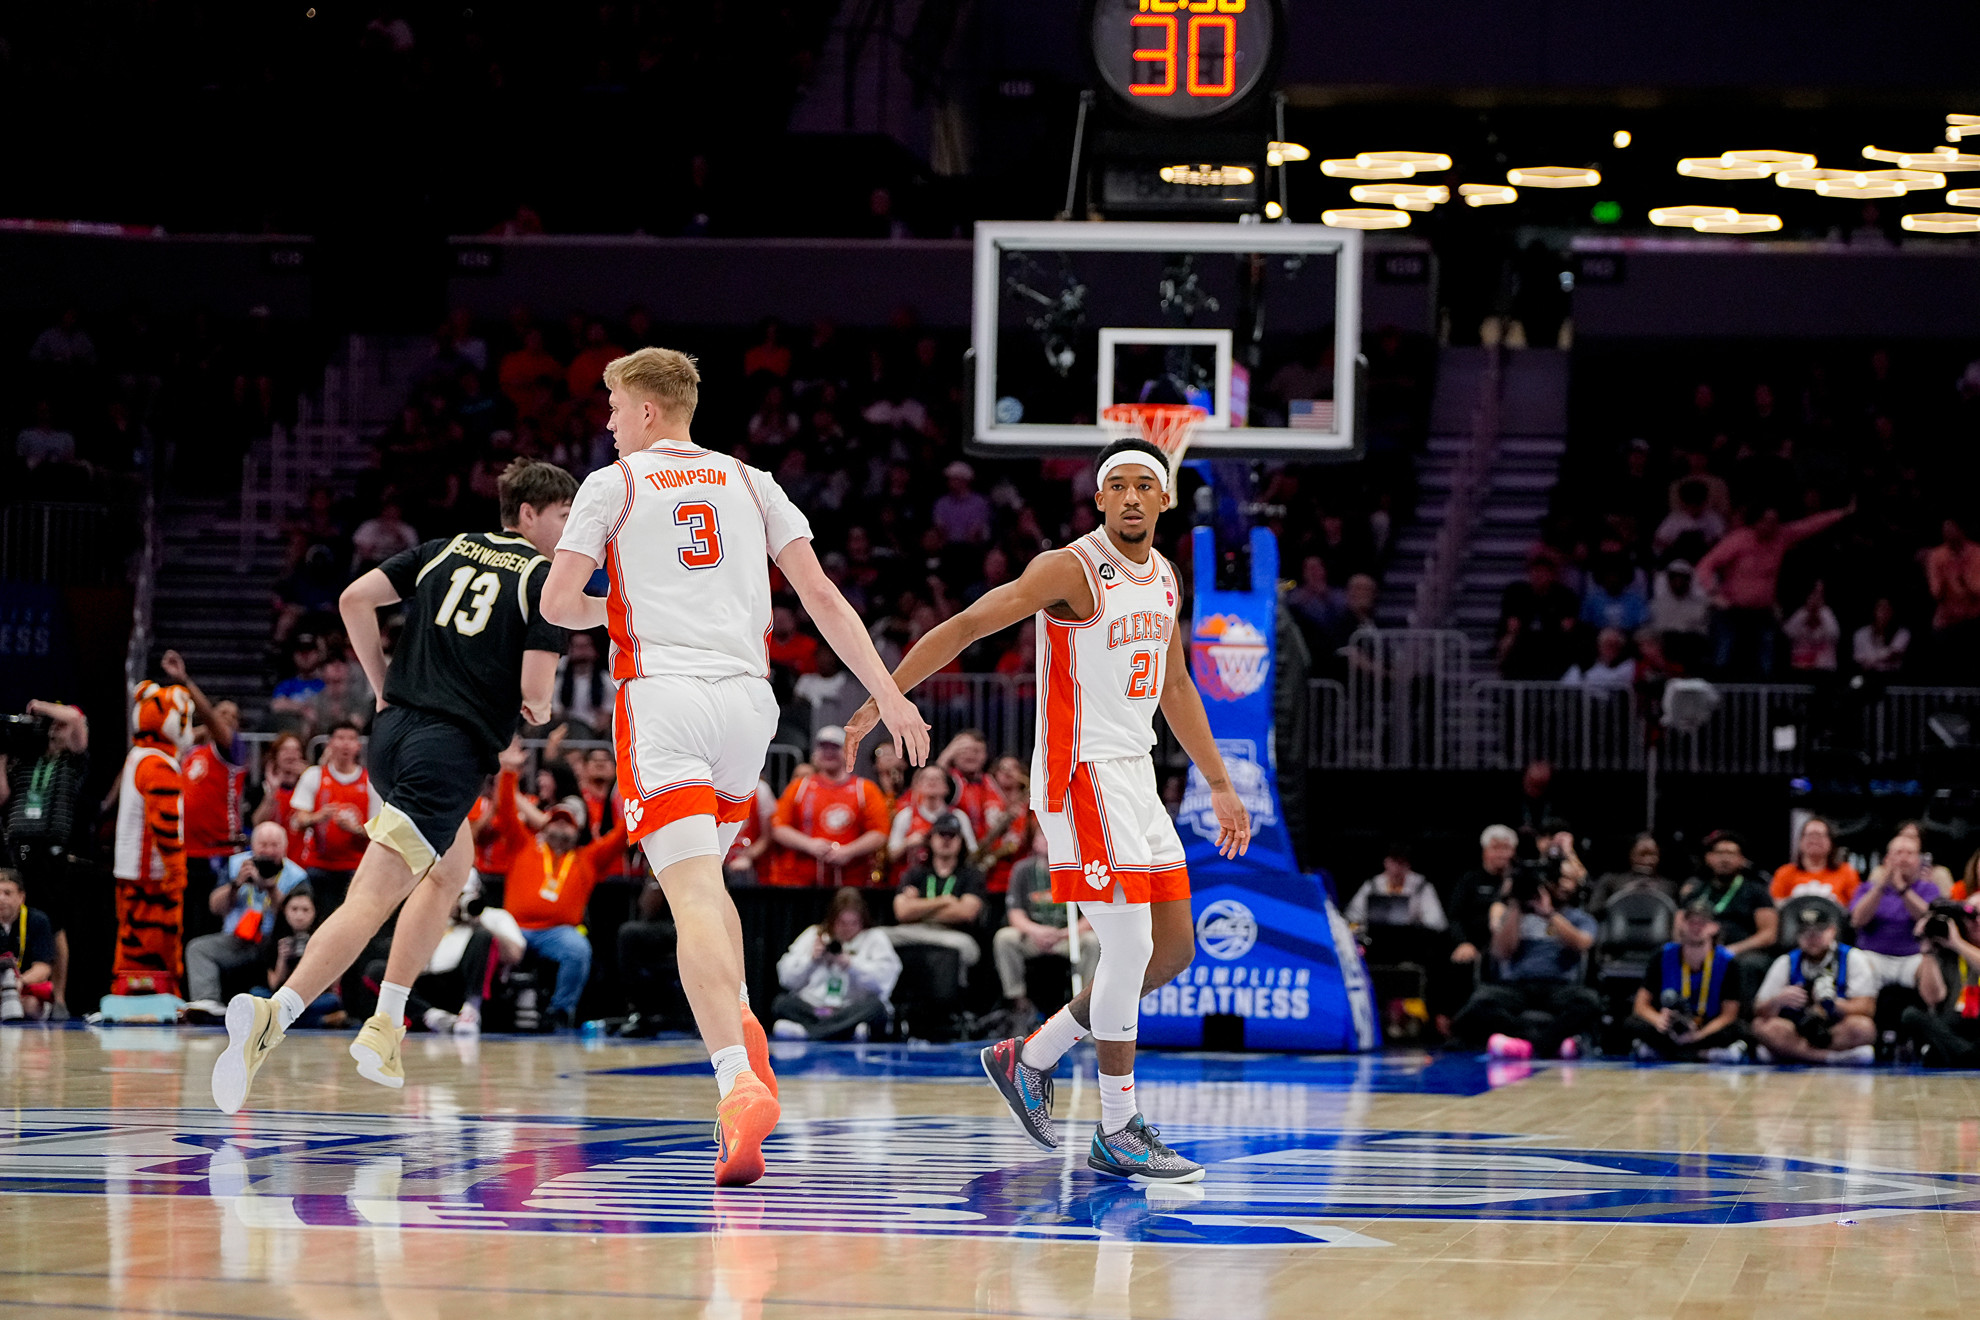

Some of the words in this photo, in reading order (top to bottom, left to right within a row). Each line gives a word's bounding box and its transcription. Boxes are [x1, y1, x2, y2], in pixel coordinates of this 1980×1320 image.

[1128, 14, 1237, 96] 30
[644, 468, 727, 491] THOMPSON
[672, 500, 725, 570] 3
[453, 540, 530, 574] SCHWIEGER
[1100, 565, 1114, 578] 41
[435, 565, 502, 637] 13
[1107, 611, 1174, 650] CLEMSO
[1125, 648, 1160, 700] 21
[1165, 965, 1311, 988] COMPLISH
[1140, 985, 1311, 1019] GREATNESS
